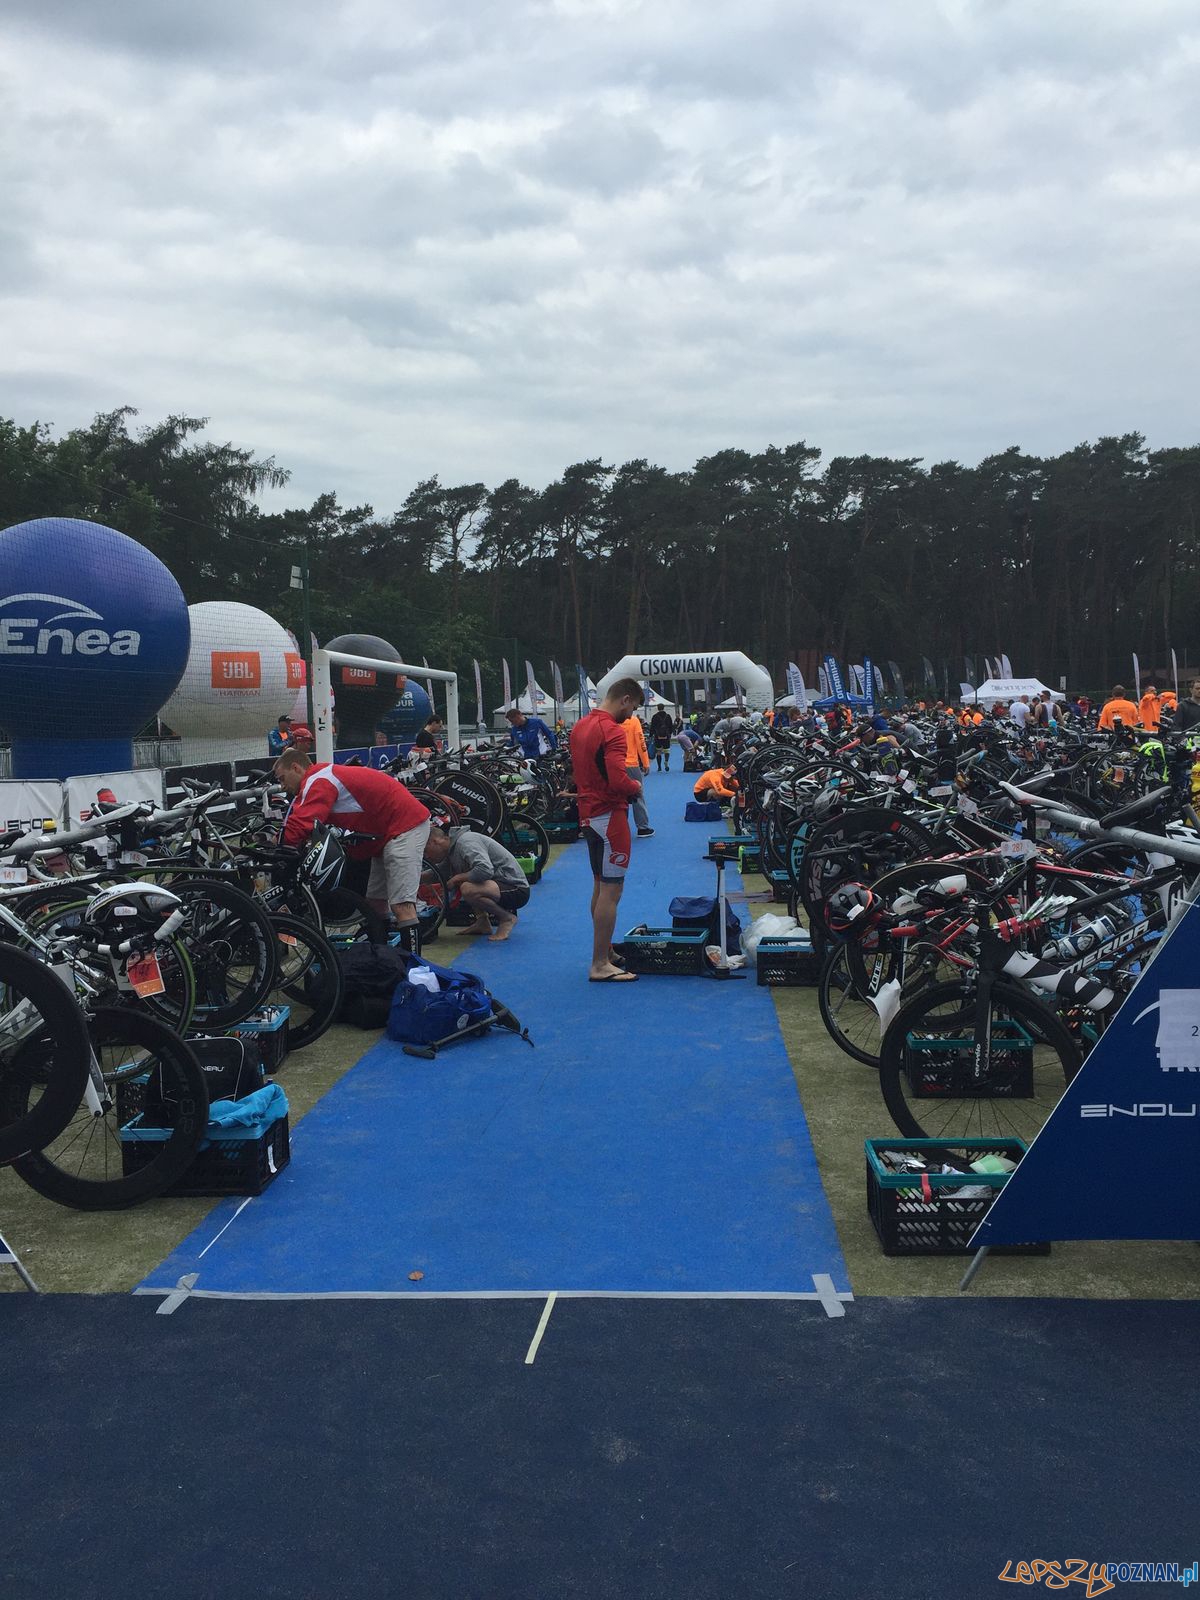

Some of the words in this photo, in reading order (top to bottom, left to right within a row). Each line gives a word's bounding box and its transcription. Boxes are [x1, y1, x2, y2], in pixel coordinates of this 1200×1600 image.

[1, 618, 141, 656] Enea
[222, 661, 254, 679] JBL
[640, 656, 724, 677] CISOWIANKA
[451, 781, 488, 804] ORIMA
[1062, 920, 1149, 974] MERIDA
[1080, 1103, 1196, 1118] ENDU
